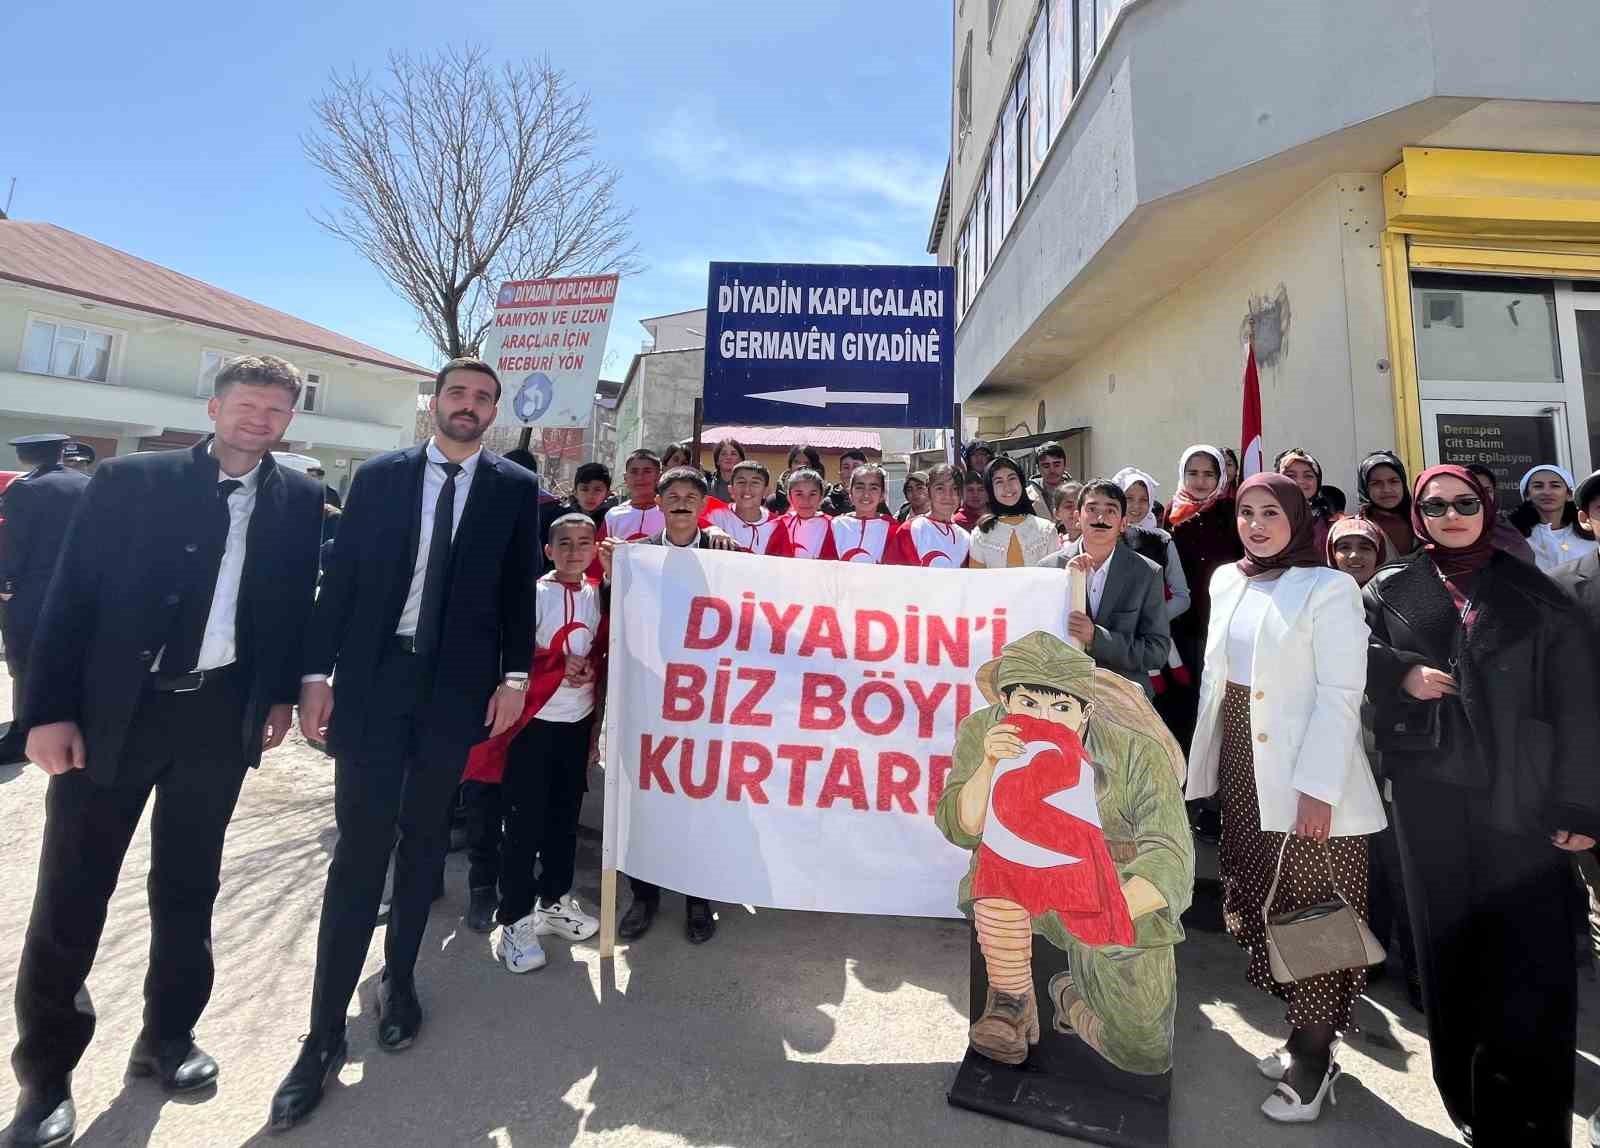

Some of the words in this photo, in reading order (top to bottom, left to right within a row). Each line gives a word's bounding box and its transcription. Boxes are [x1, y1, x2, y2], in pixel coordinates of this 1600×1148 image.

[514, 281, 551, 302] DİYADİN
[718, 279, 802, 314] DİYADİN
[808, 287, 944, 317] KAPLICALARI
[495, 312, 547, 327] KAMYON
[552, 310, 568, 324] VE
[572, 309, 608, 324] UZUN
[501, 334, 559, 351] ARAÇLAR
[562, 328, 590, 349] İÇİN
[720, 325, 836, 360] GERMAVÊN
[841, 327, 940, 363] GIYADÎNÊ
[559, 351, 584, 369] YÖN
[1446, 452, 1476, 462] Lazer
[1479, 453, 1533, 464] Epilasyon
[661, 658, 776, 728] BİZ
